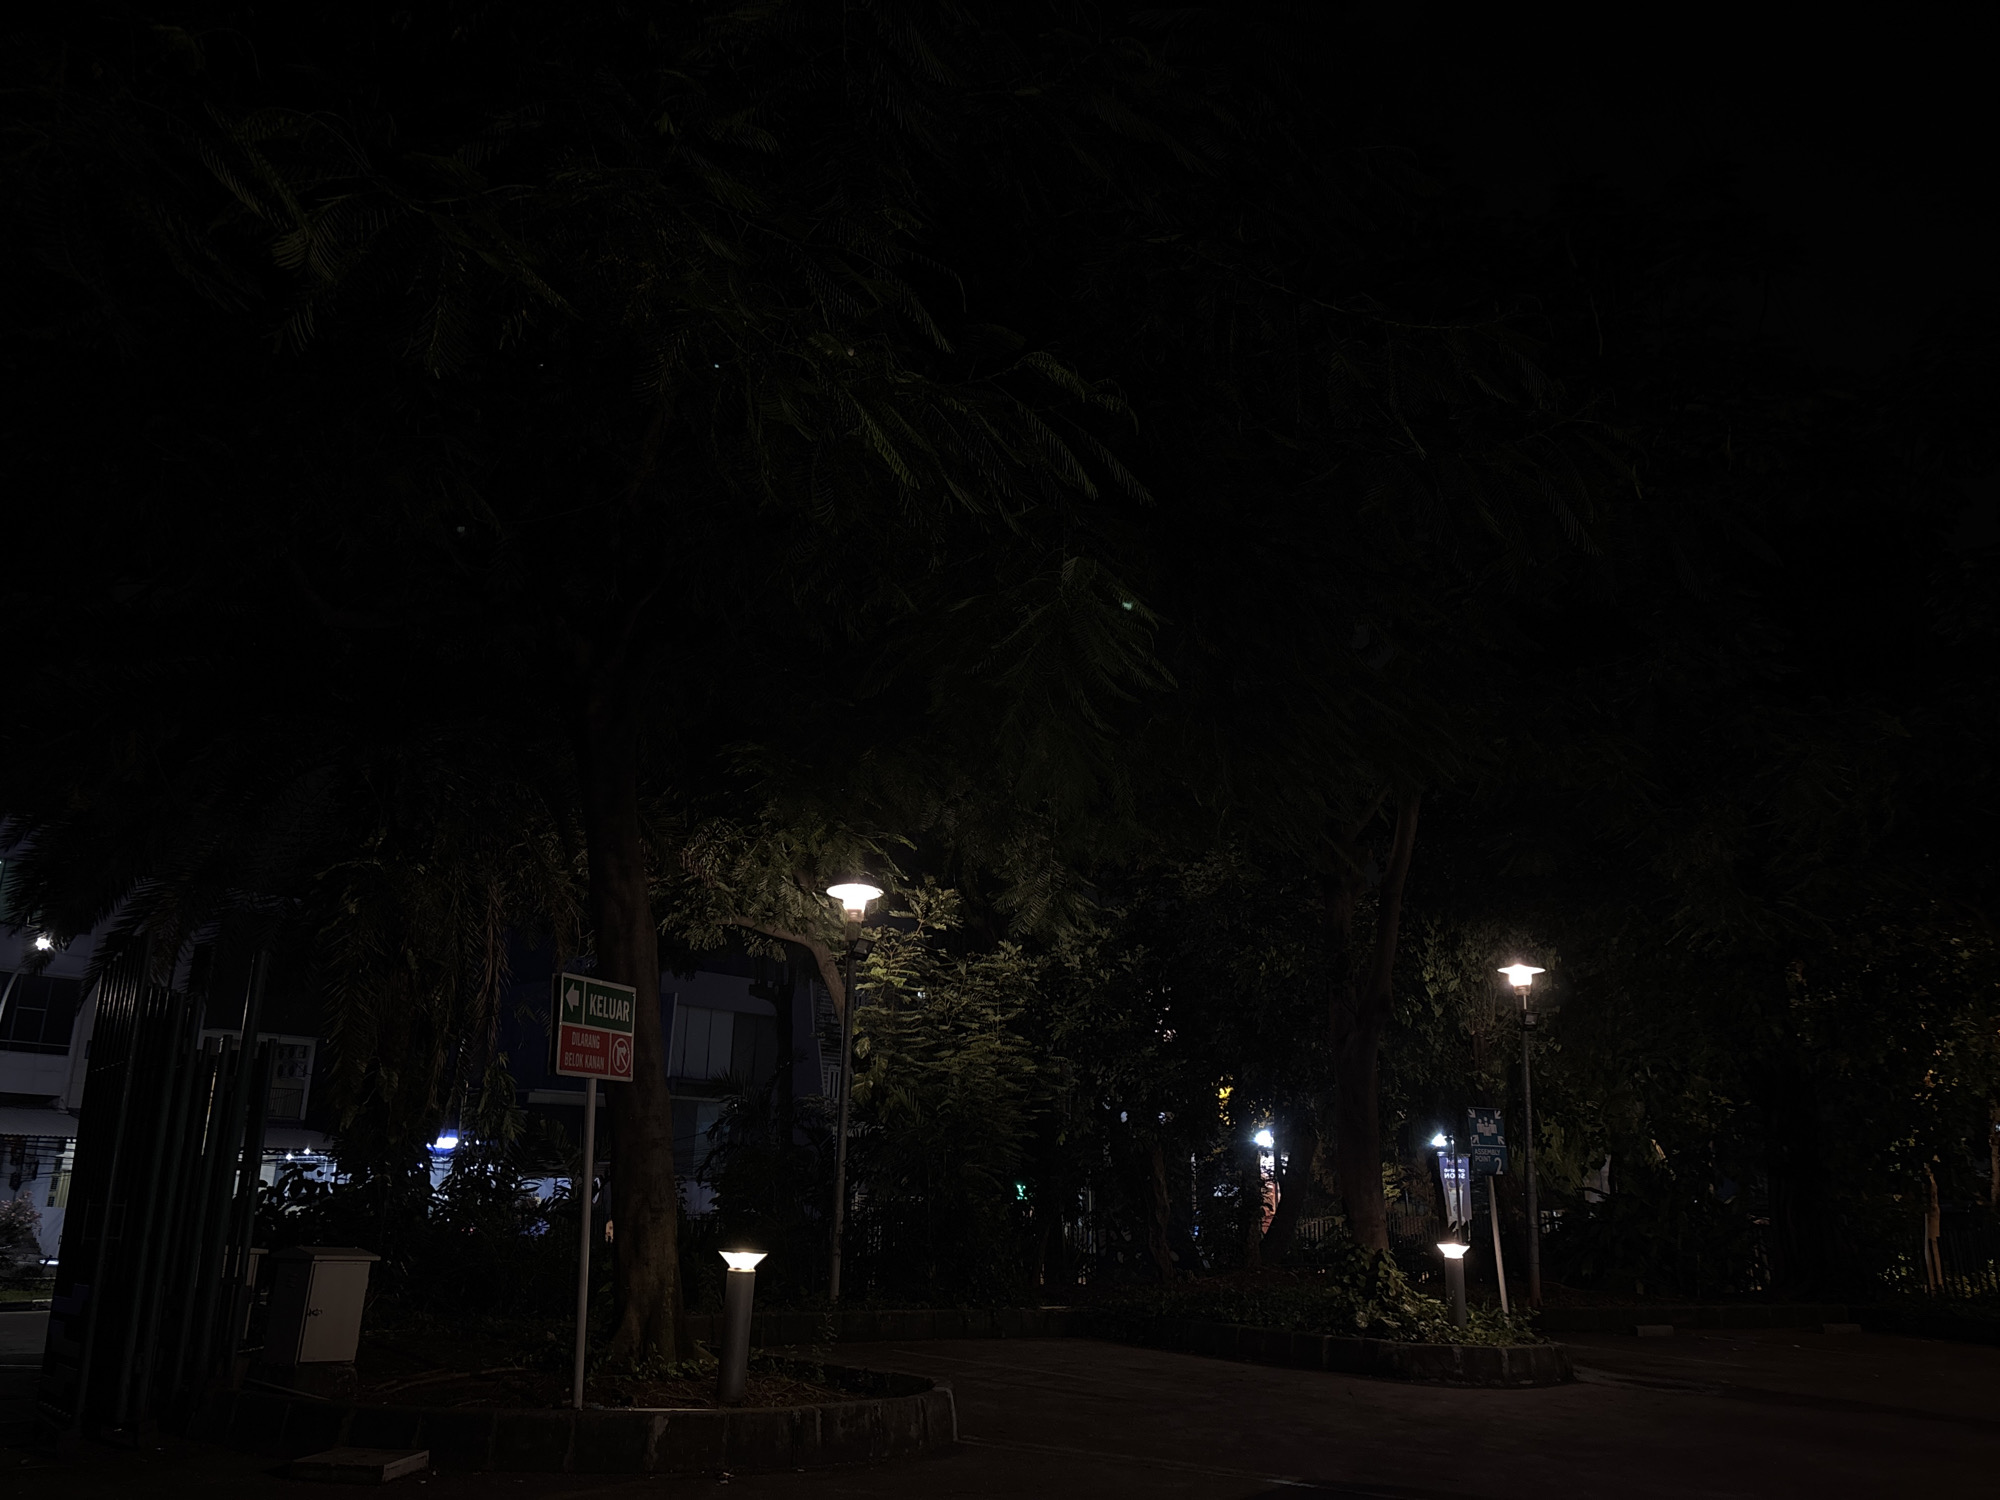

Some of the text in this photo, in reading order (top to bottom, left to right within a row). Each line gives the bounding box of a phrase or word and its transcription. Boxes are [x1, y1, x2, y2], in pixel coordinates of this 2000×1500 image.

[589, 993, 630, 1022] KELUAR
[571, 1031, 600, 1049] DILARANG
[564, 1051, 605, 1070] BELOK KANAN
[1474, 1148, 1500, 1156] ASSEMBLY
[1494, 1157, 1504, 1175] 2
